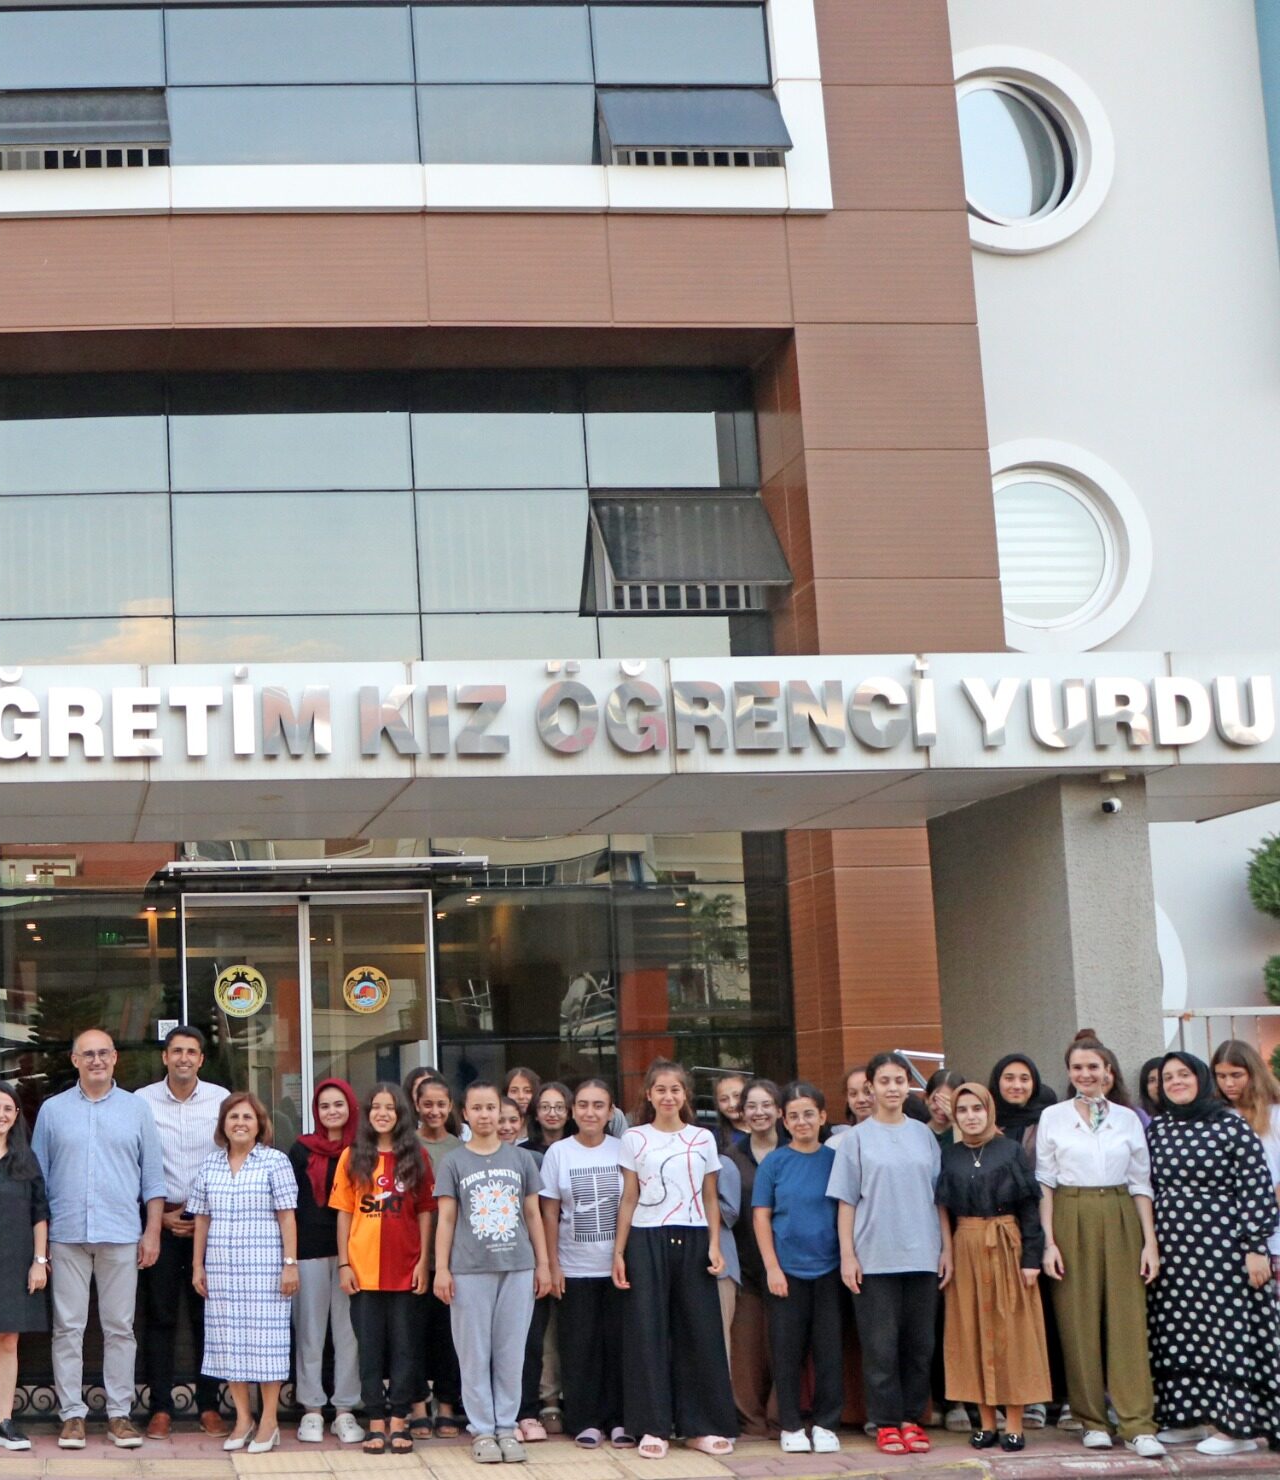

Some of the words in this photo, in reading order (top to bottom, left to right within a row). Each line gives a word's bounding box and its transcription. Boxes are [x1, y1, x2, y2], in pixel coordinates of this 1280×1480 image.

[359, 684, 511, 756] KIZ
[536, 659, 937, 753] ÖĞRENCİ
[961, 674, 1277, 750] YURDU
[460, 1170, 486, 1190] THINK
